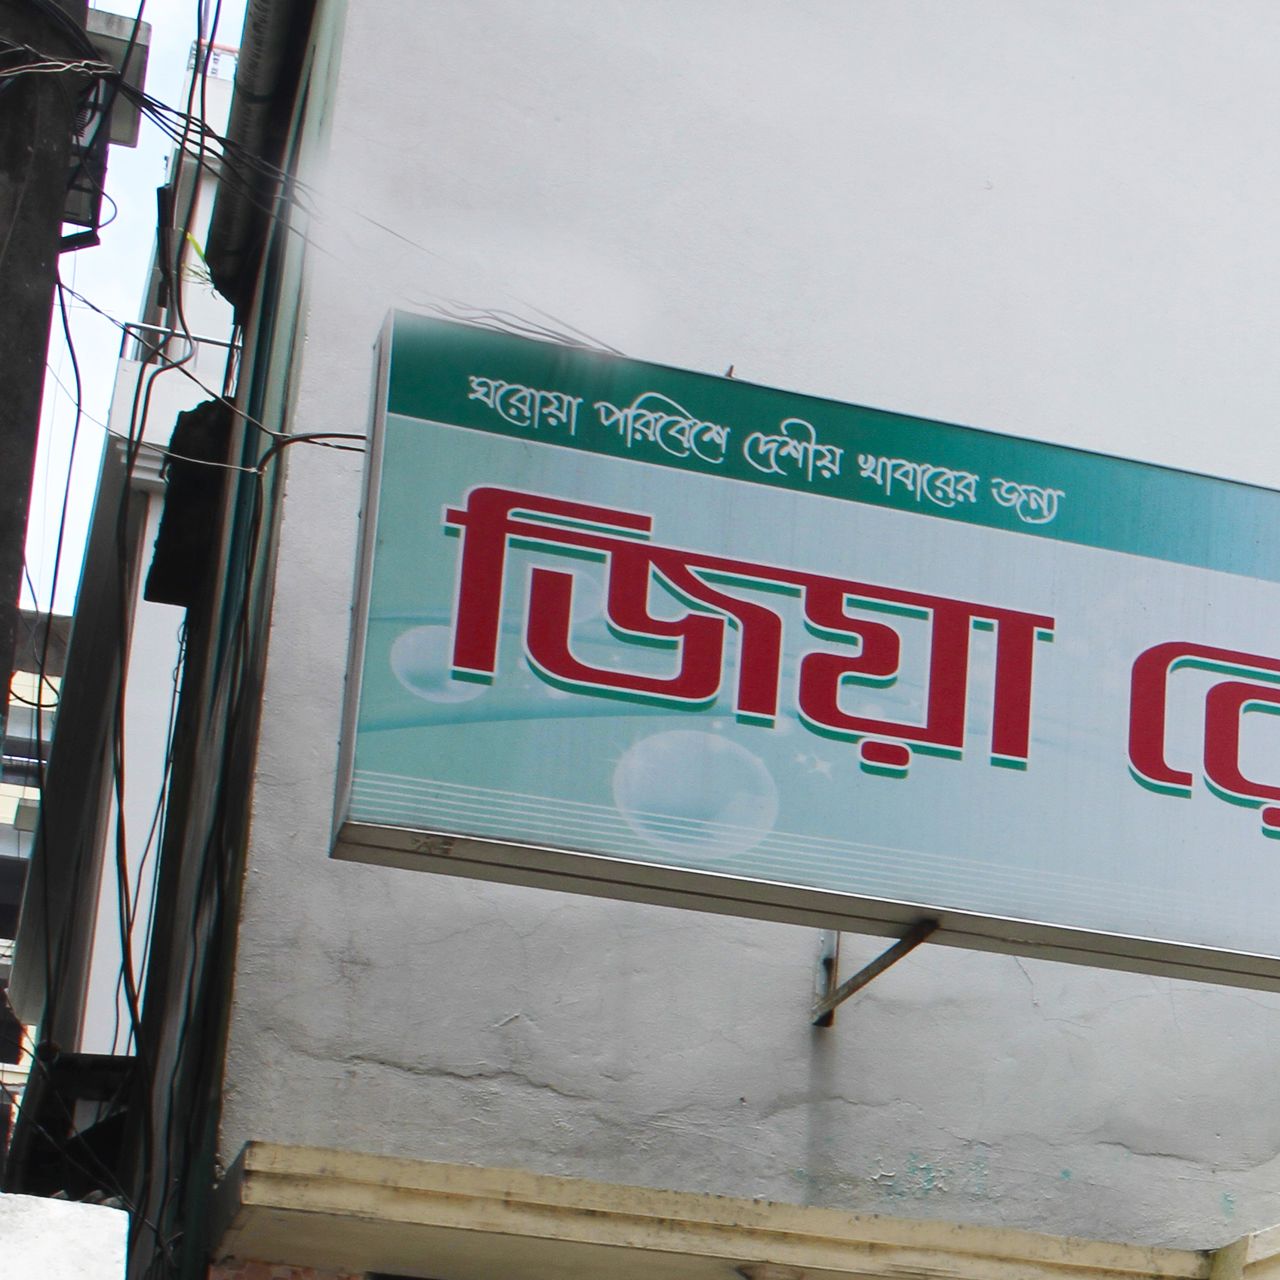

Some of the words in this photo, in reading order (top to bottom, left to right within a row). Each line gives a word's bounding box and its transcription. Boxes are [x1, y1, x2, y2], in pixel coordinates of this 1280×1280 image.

[469, 375, 583, 436] ঘরোয়া
[593, 392, 730, 463] পরিবেশে
[743, 418, 842, 481] দেশীয়
[857, 453, 978, 506] খাবারের
[991, 477, 1065, 523] জন্য
[442, 485, 1056, 778] জিয়া
